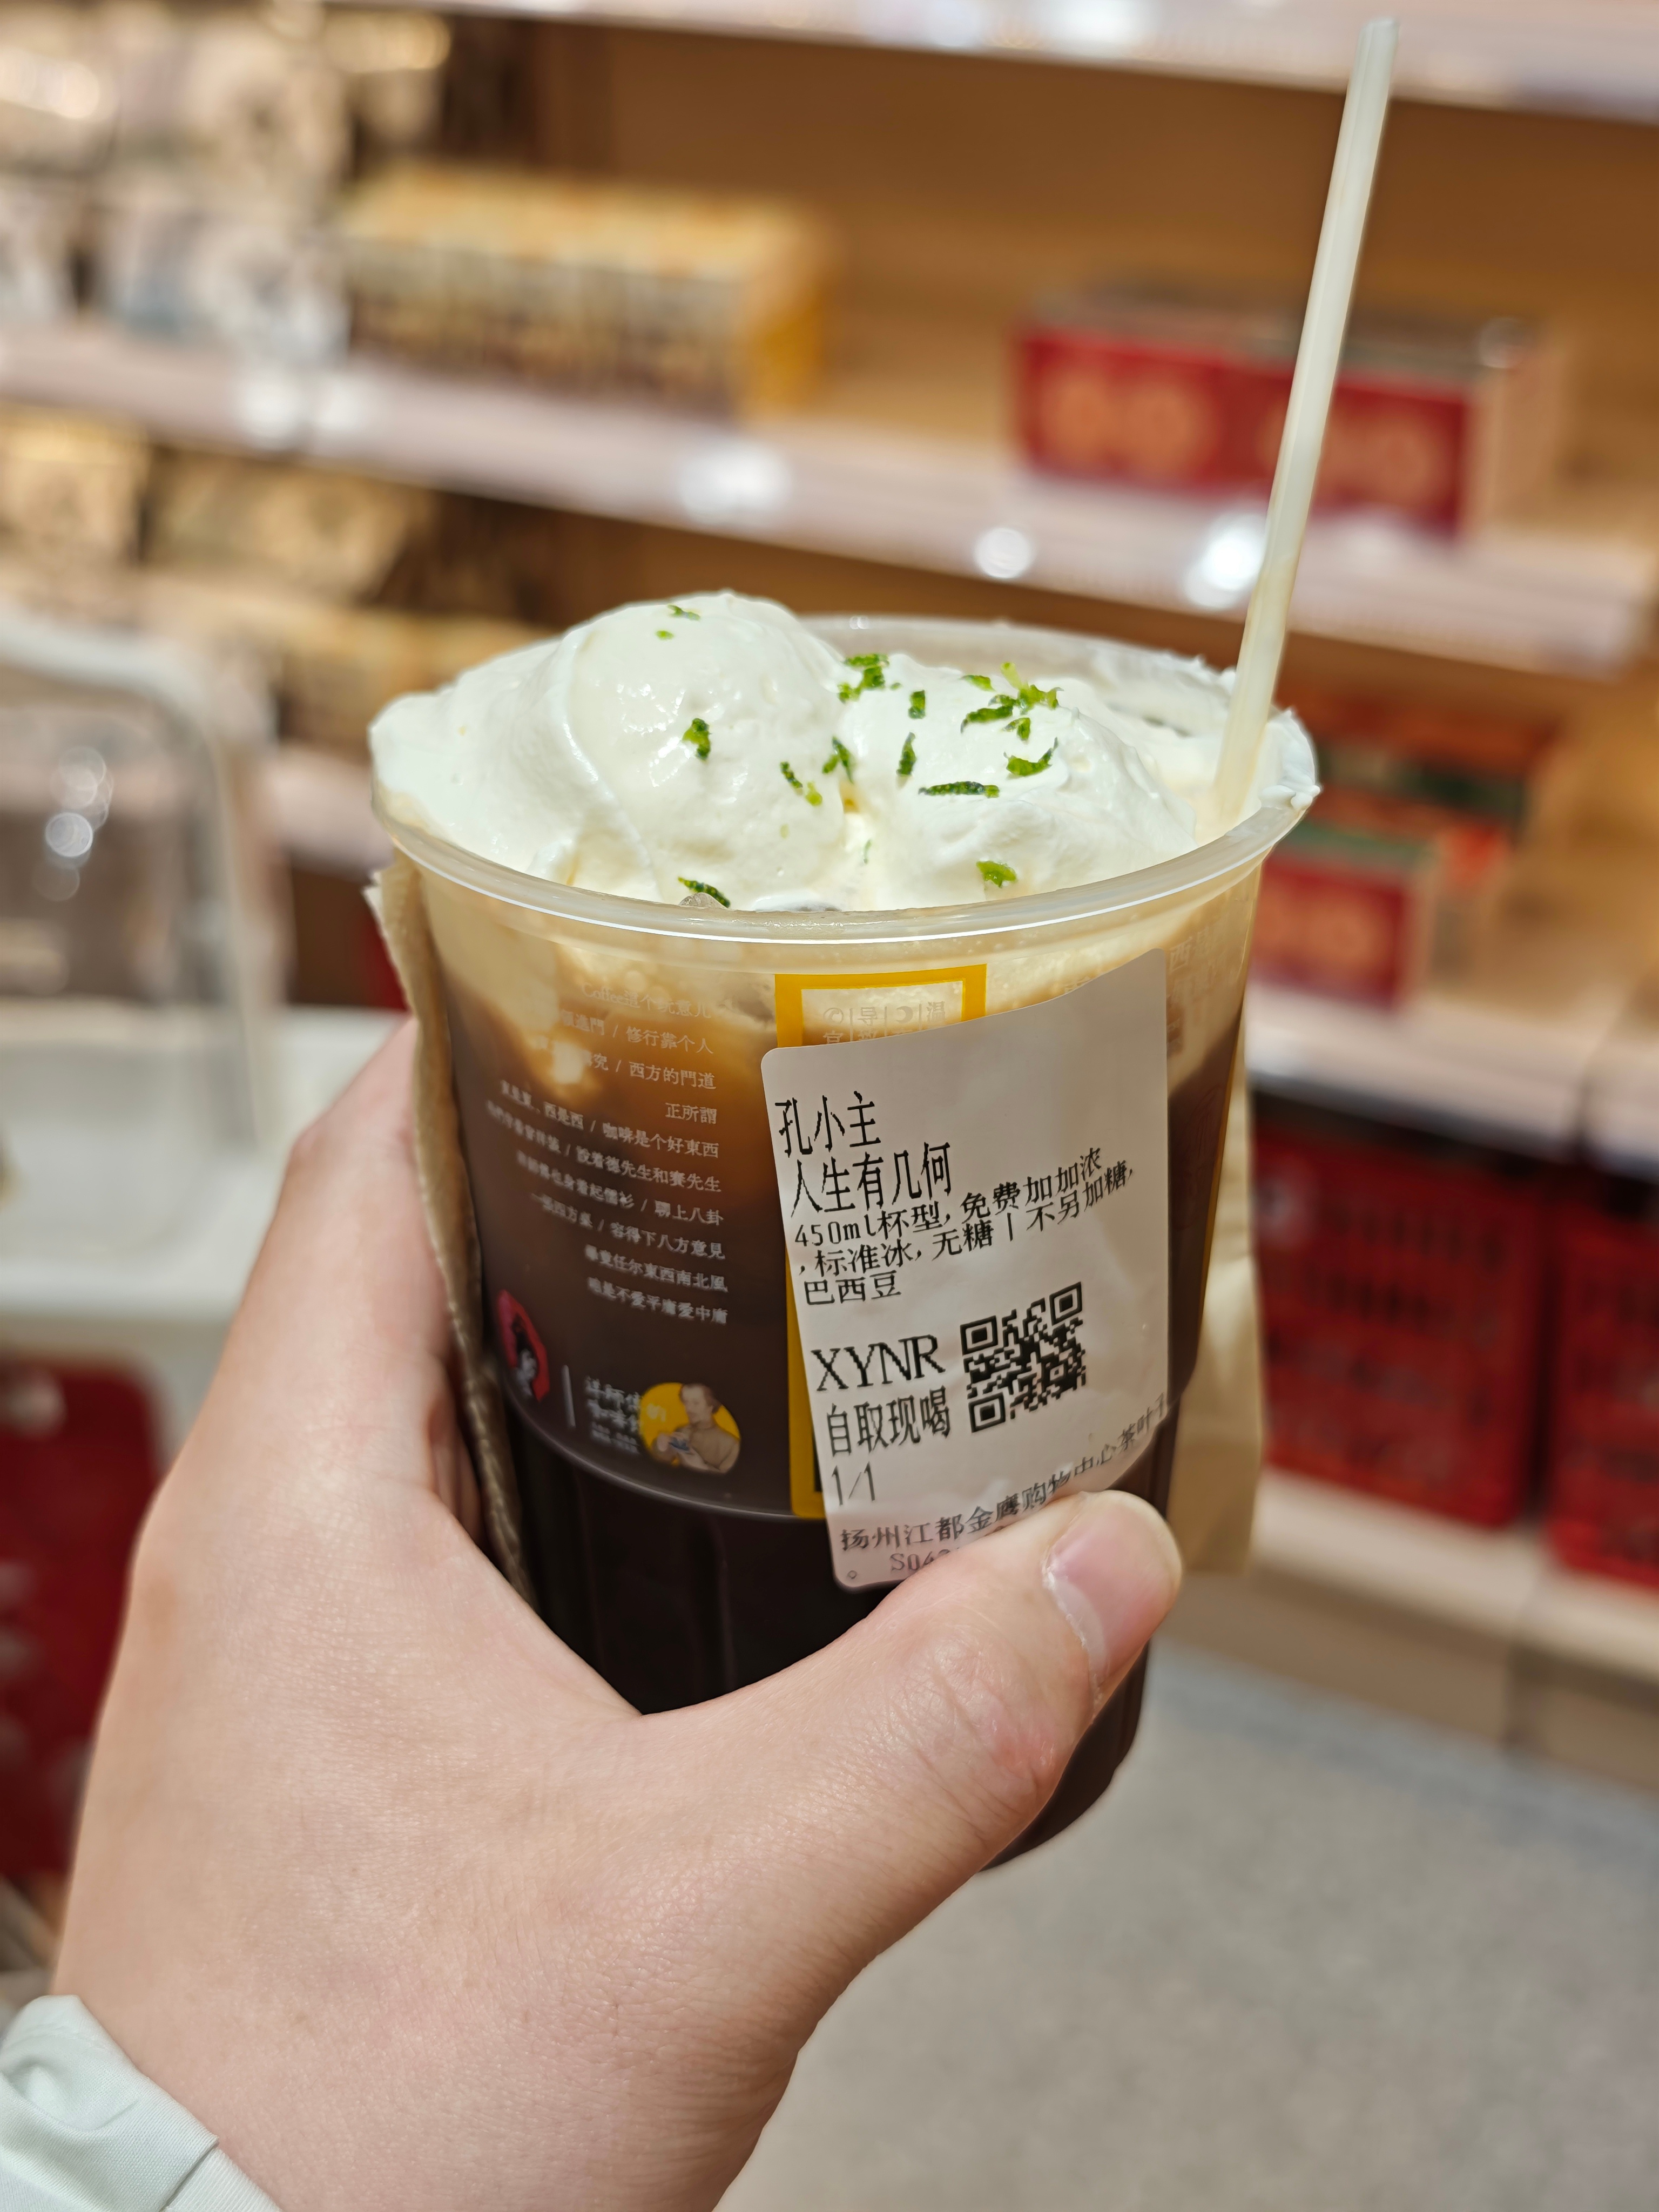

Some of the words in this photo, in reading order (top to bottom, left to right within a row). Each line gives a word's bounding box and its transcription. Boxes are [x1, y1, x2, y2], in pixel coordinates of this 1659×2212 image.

[629, 1061, 717, 1090] 西方的門道
[665, 1102, 718, 1125] 正所謂
[774, 1091, 882, 1158] 孔小主
[791, 1142, 952, 1218] 人生有几何
[804, 1270, 903, 1306] 巴西豆
[811, 1334, 947, 1392] XYNR
[826, 1385, 952, 1457] 自取现喝
[831, 1461, 876, 1507] 1/1
